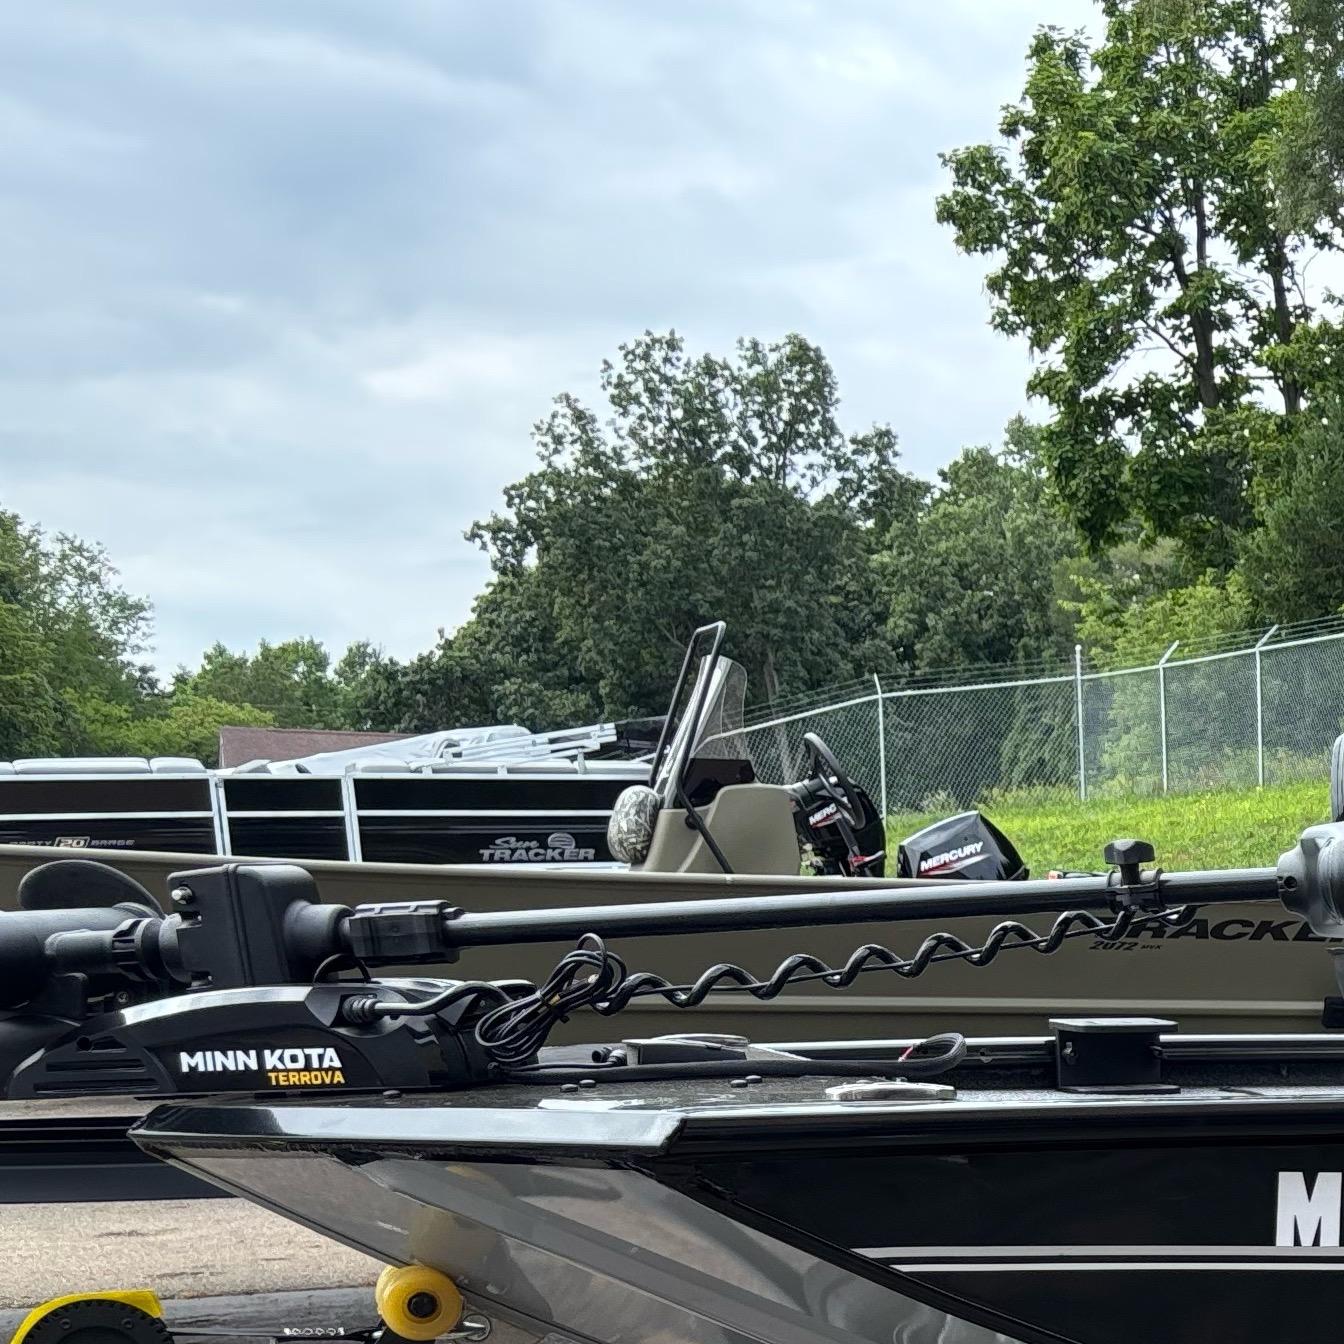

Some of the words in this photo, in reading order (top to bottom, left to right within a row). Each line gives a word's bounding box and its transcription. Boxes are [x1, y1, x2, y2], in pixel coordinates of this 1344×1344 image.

[479, 848, 596, 861] TRACKER
[920, 841, 984, 872] MERCURY
[180, 1050, 259, 1073] MINN
[264, 1047, 343, 1070] KOTA
[268, 1070, 345, 1086] TERROVA
